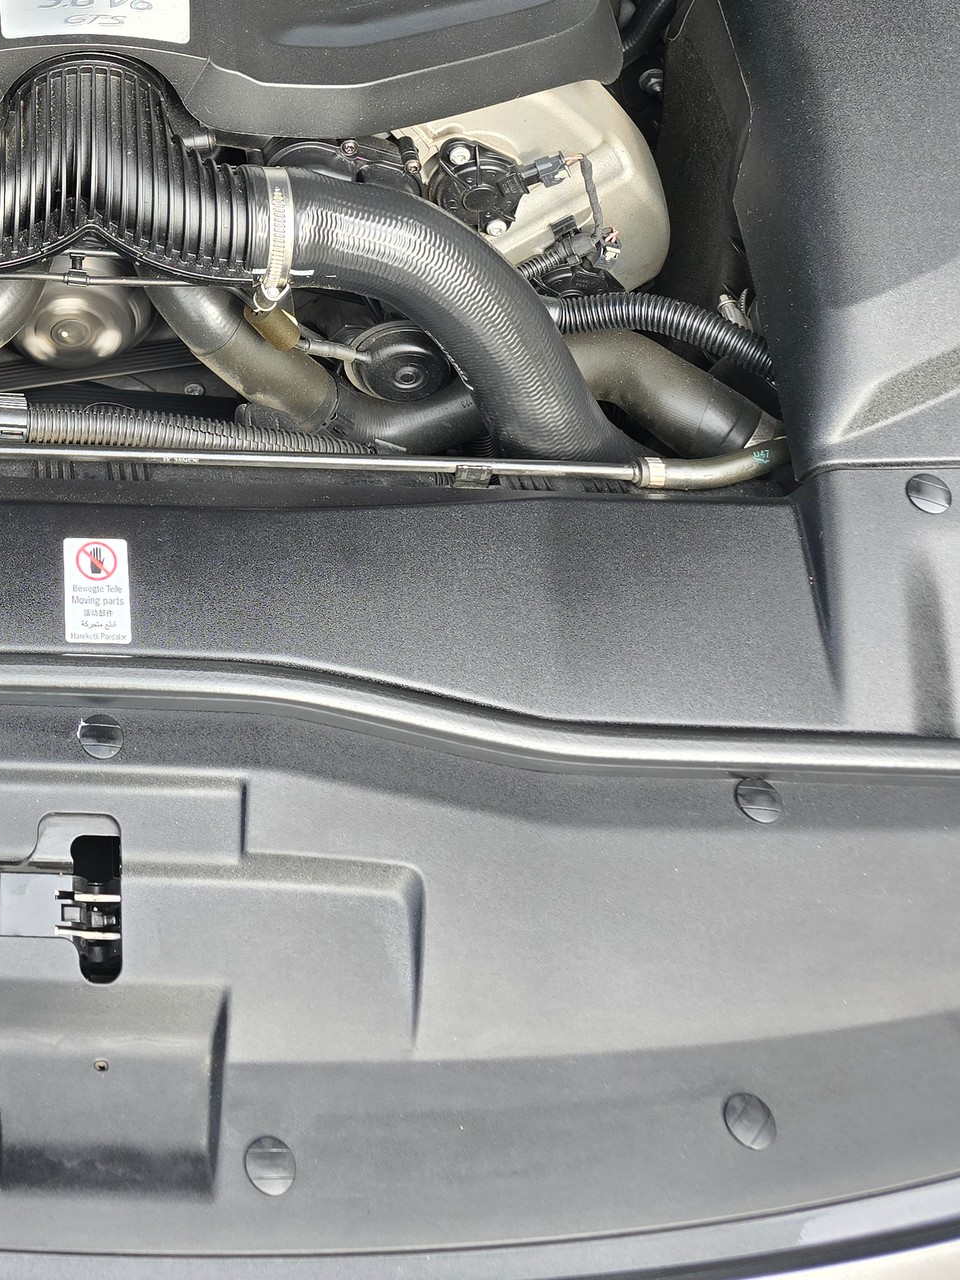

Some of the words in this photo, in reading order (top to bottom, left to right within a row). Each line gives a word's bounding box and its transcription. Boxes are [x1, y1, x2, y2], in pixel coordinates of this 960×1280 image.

[64, 13, 128, 27] GTS
[72, 584, 104, 594] Bewegte
[106, 584, 123, 594] Teile
[71, 595, 101, 607] Moving
[102, 597, 125, 607] parts
